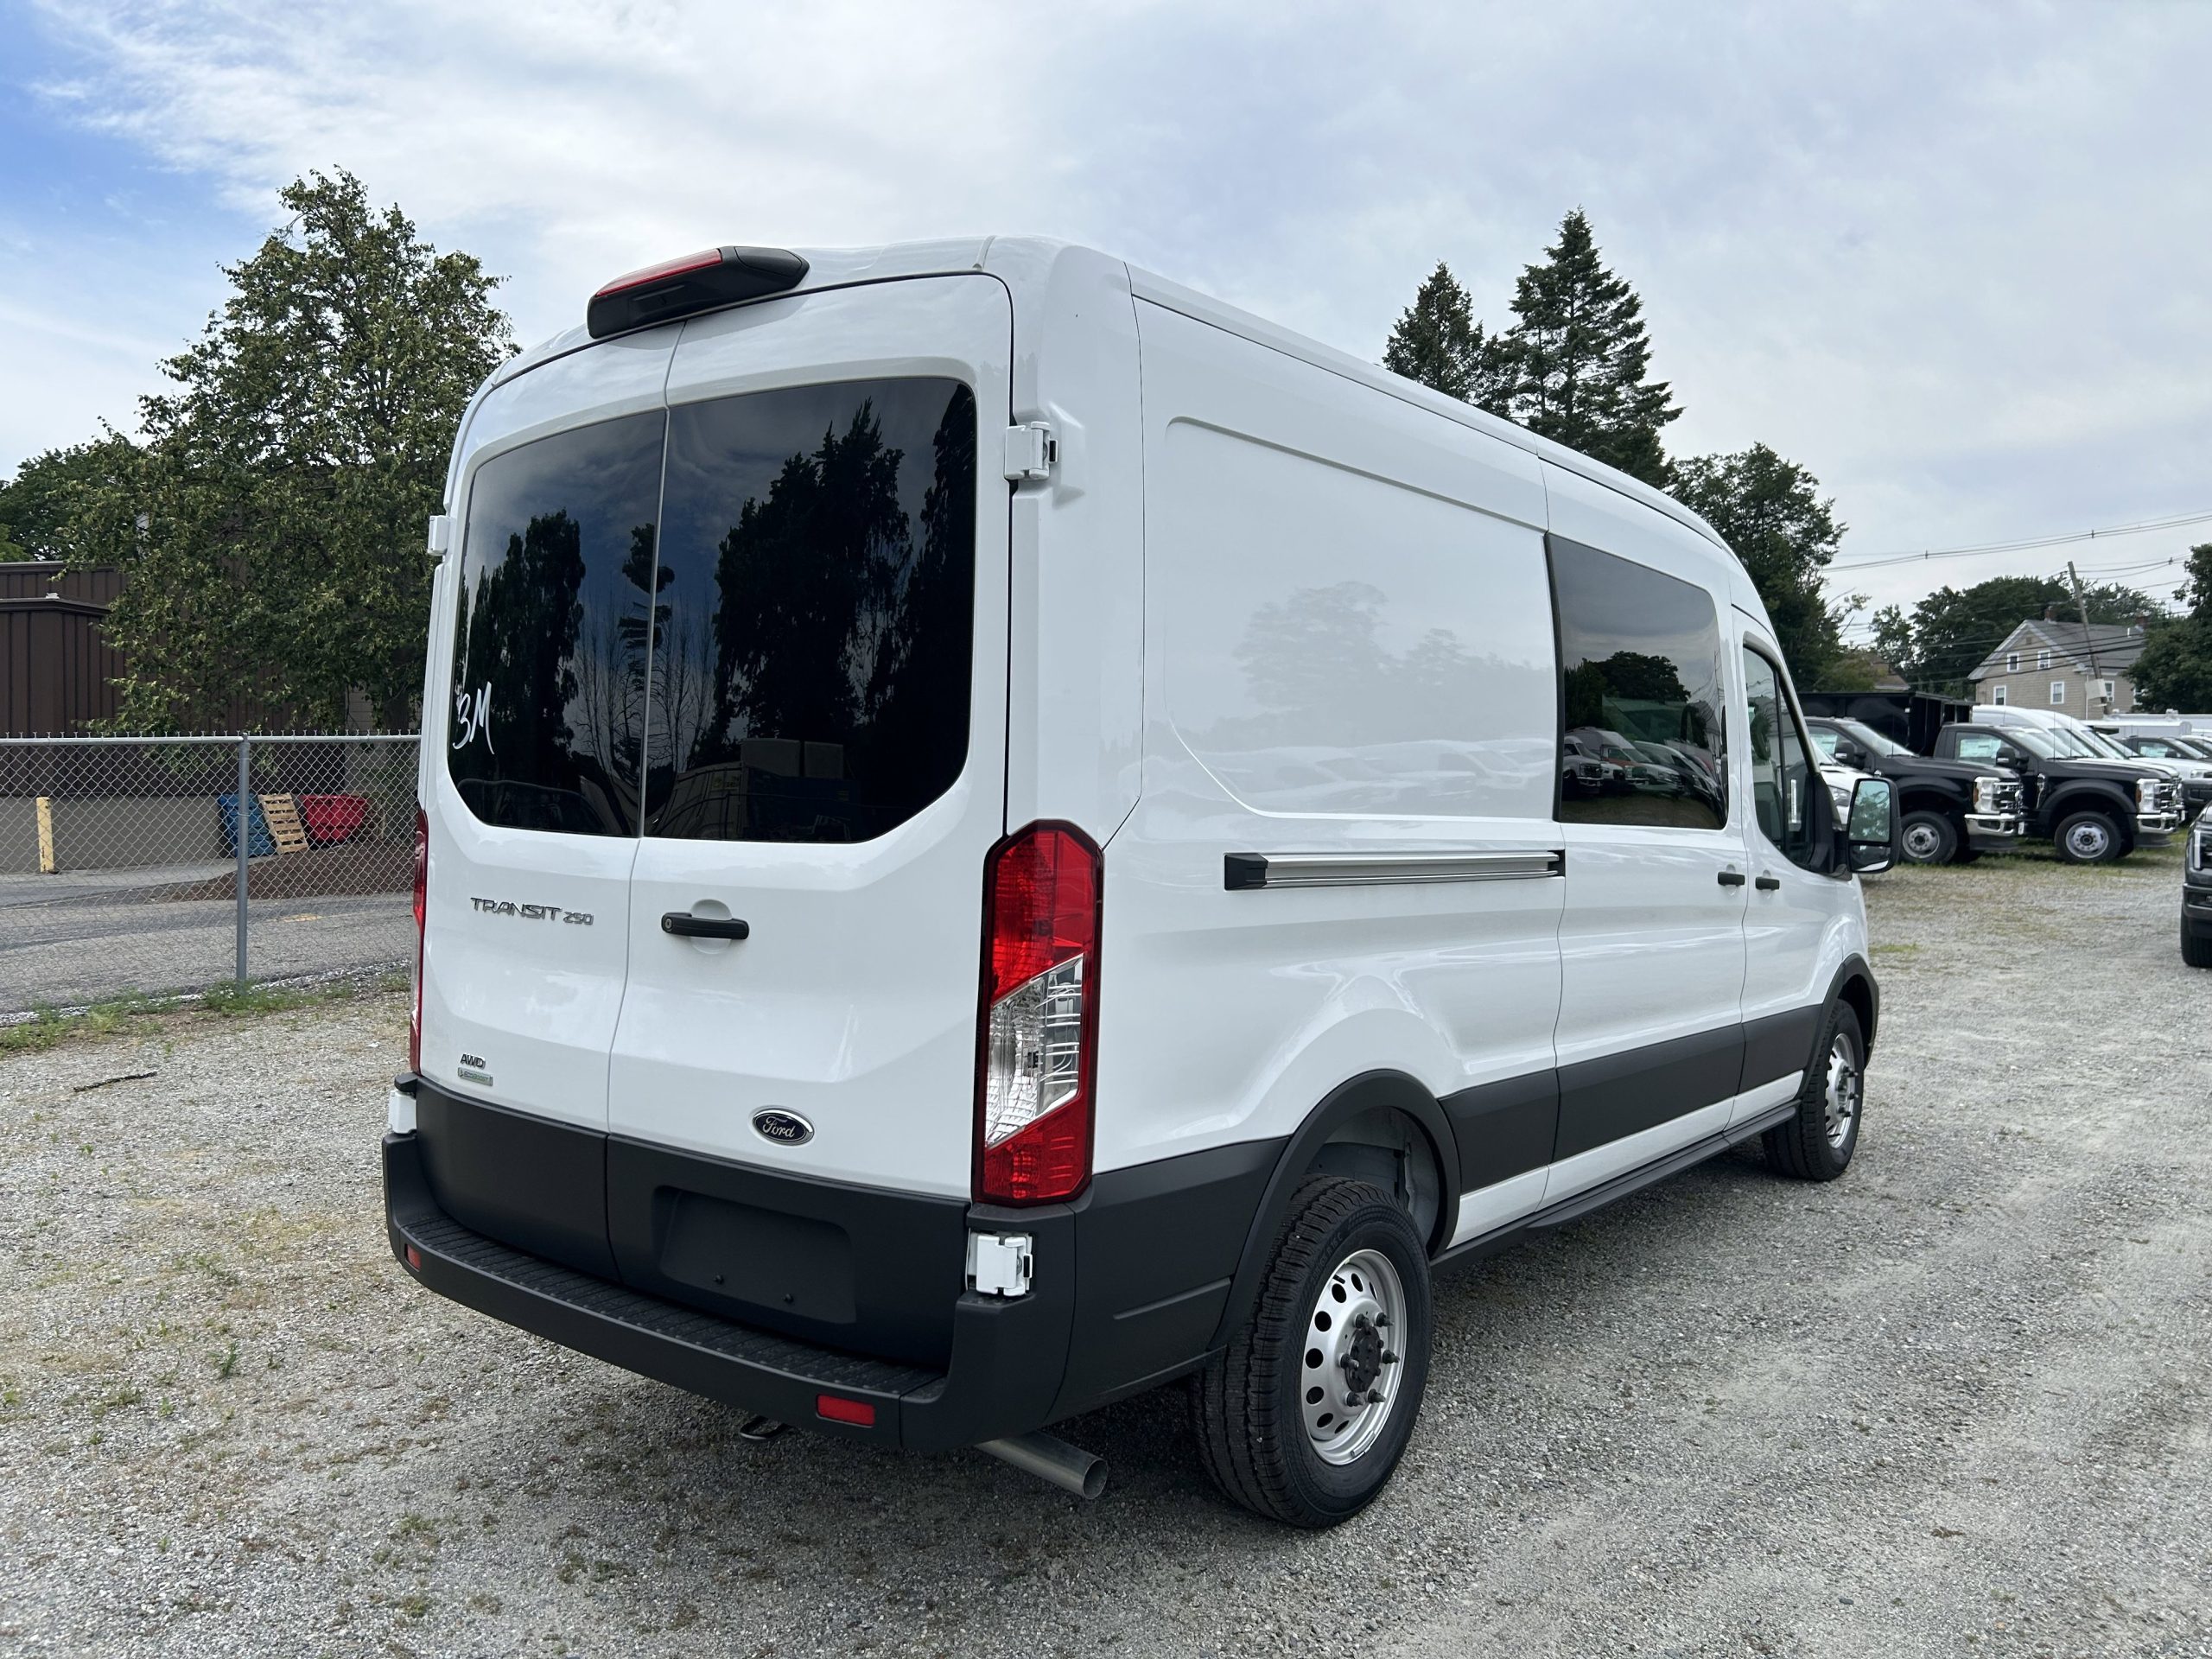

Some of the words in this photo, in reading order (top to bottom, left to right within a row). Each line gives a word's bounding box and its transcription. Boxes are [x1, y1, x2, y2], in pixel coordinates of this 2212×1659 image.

[470, 897, 563, 921] TRANSIT
[563, 911, 594, 925] 250
[460, 1052, 486, 1070] AWD
[762, 1116, 796, 1138] Ford
